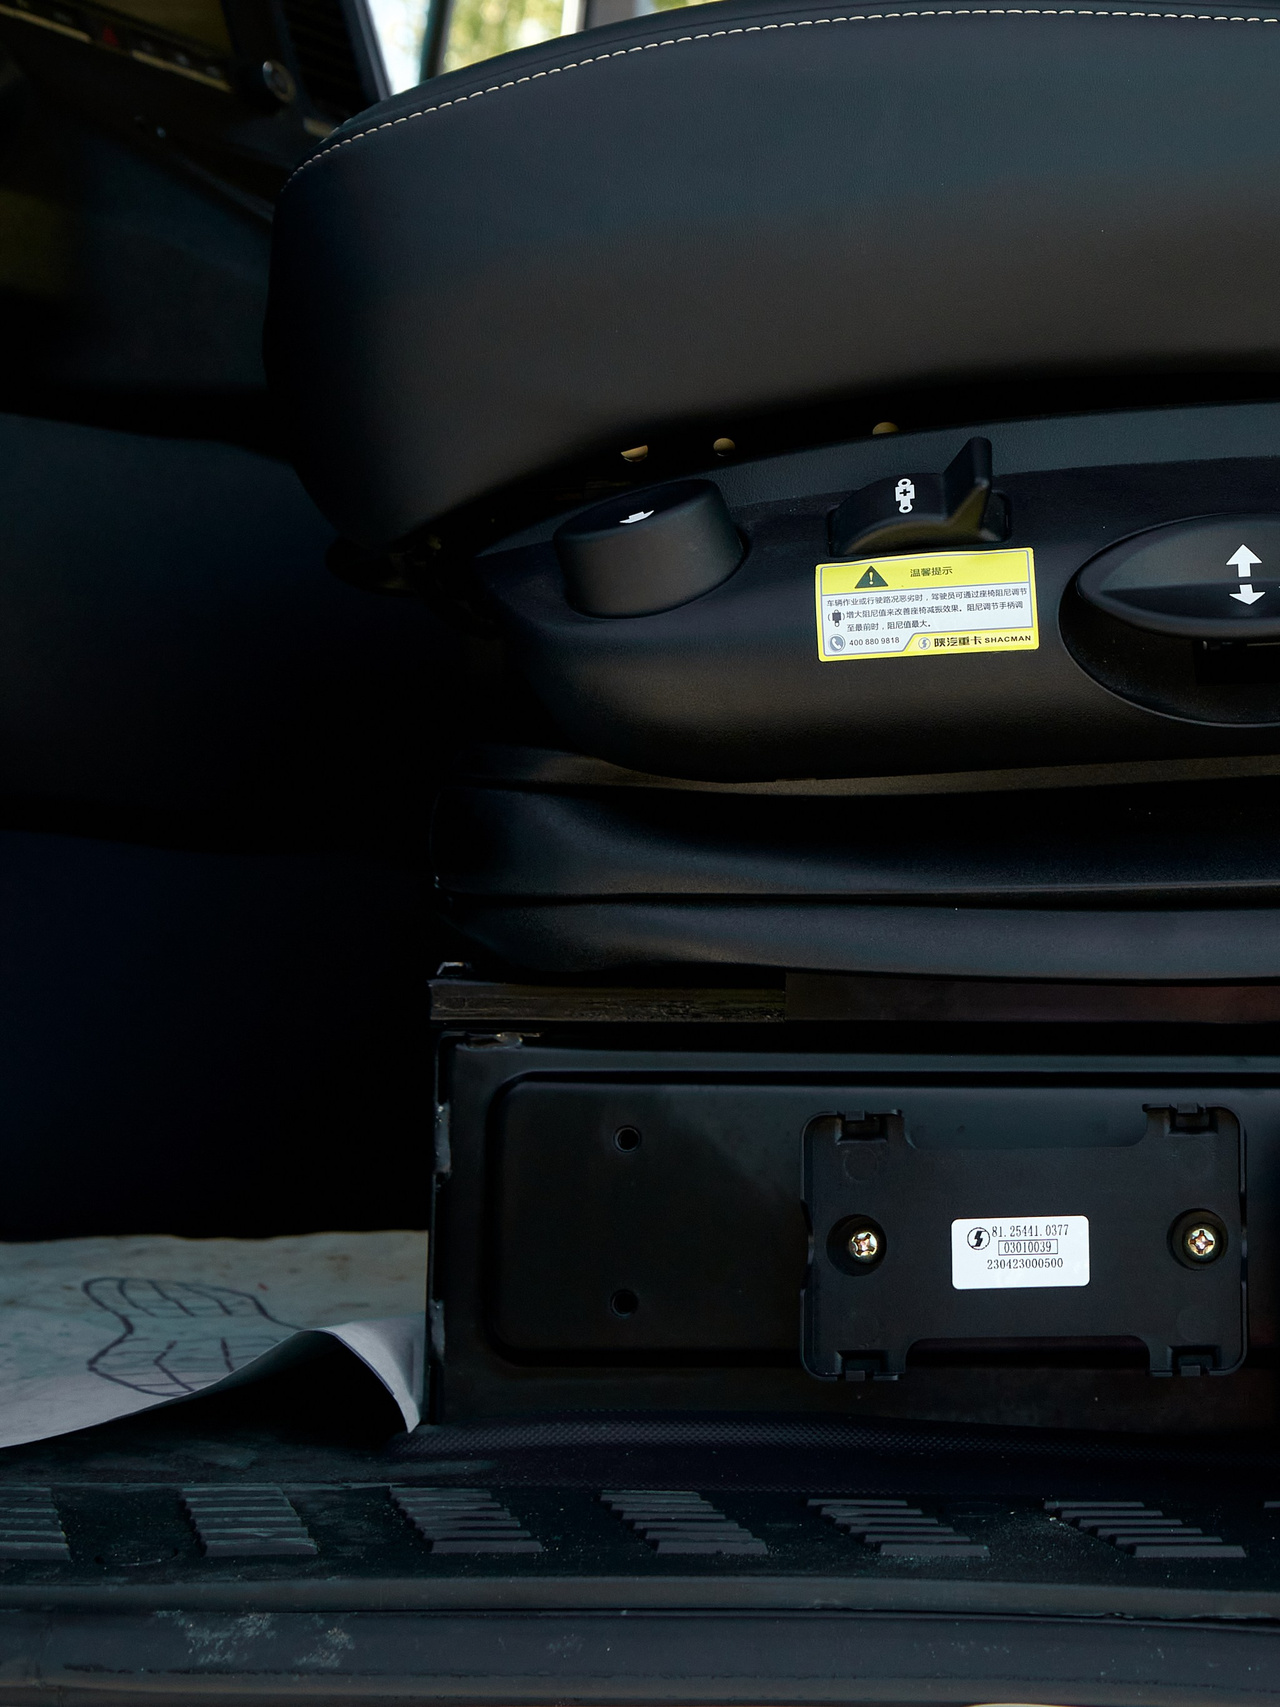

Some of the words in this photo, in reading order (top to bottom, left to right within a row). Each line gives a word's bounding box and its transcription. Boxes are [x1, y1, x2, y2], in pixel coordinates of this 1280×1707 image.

[910, 566, 953, 577] 温馨提示
[849, 638, 864, 646] 400
[865, 638, 879, 646] 880
[881, 637, 900, 645] 9818
[933, 635, 982, 648] 陕汽重卡
[984, 635, 1032, 643] SHACMAN
[1003, 1241, 1052, 1253] 03010039
[986, 1257, 1064, 1270] 230423000500
